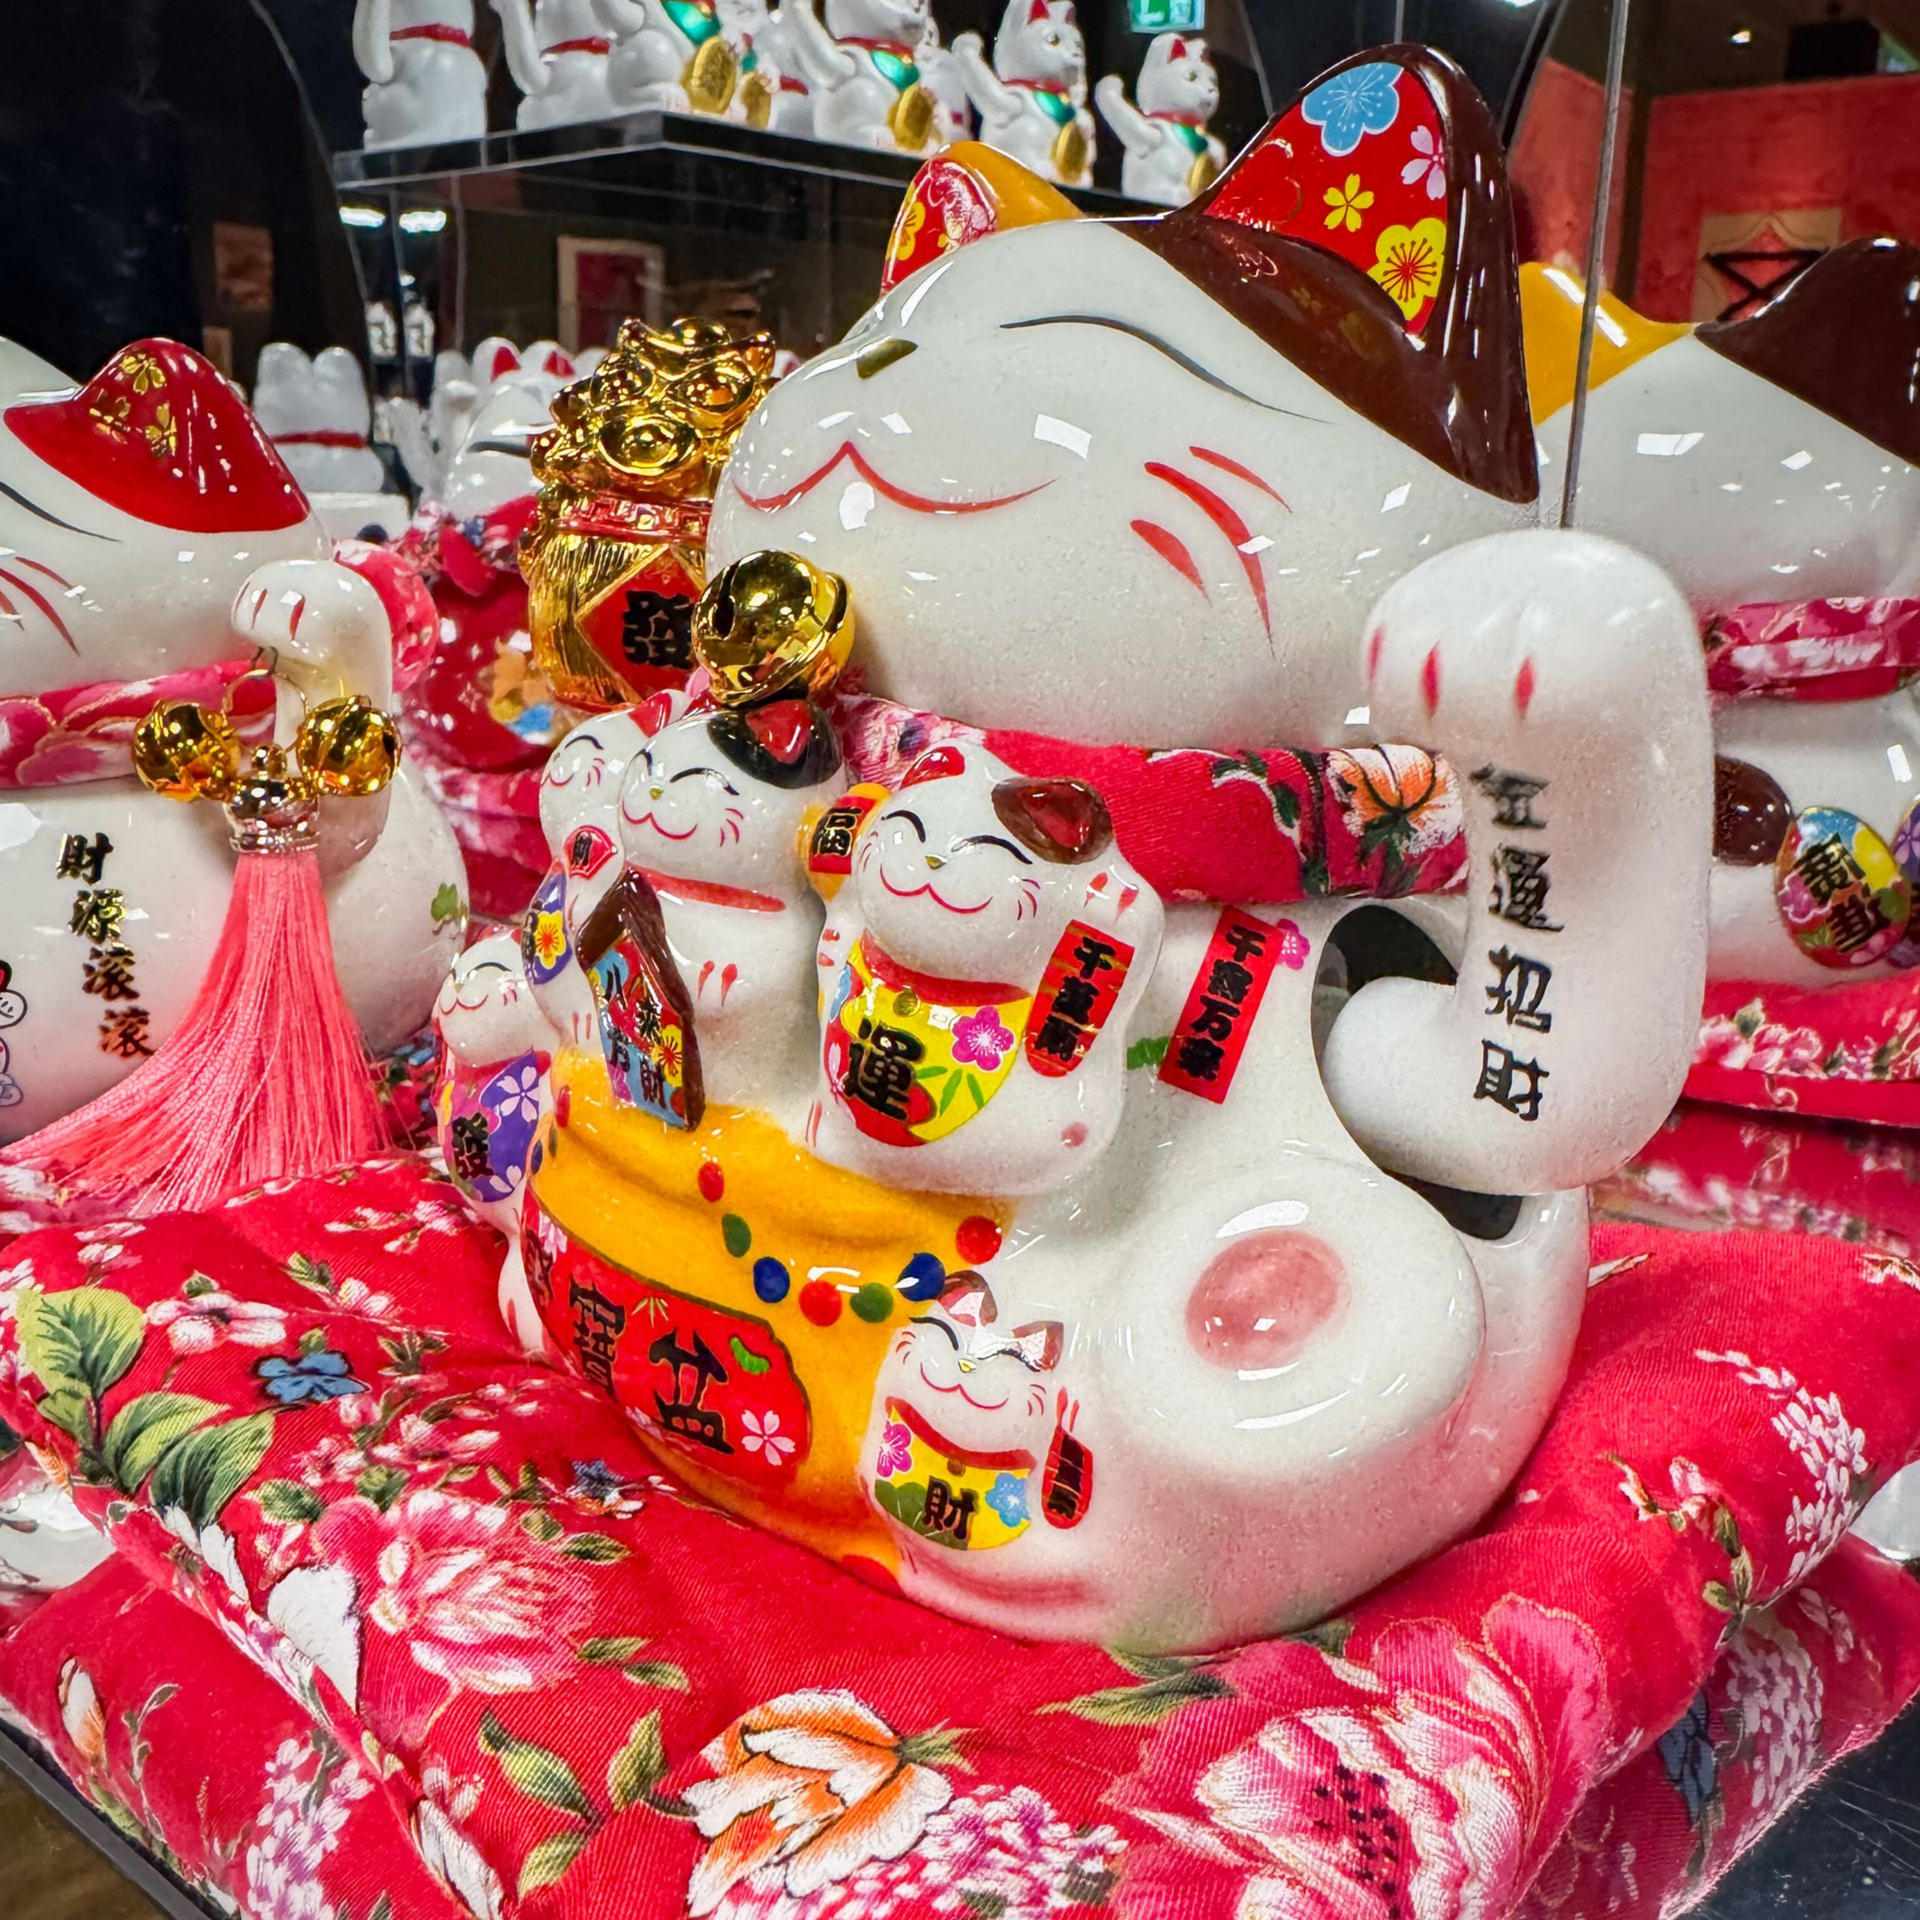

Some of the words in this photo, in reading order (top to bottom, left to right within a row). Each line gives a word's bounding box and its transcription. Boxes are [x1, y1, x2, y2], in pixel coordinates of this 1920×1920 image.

[622, 589, 694, 671] 發
[810, 807, 863, 857] 福
[842, 1018, 926, 1122] 運
[922, 1474, 980, 1541] 財
